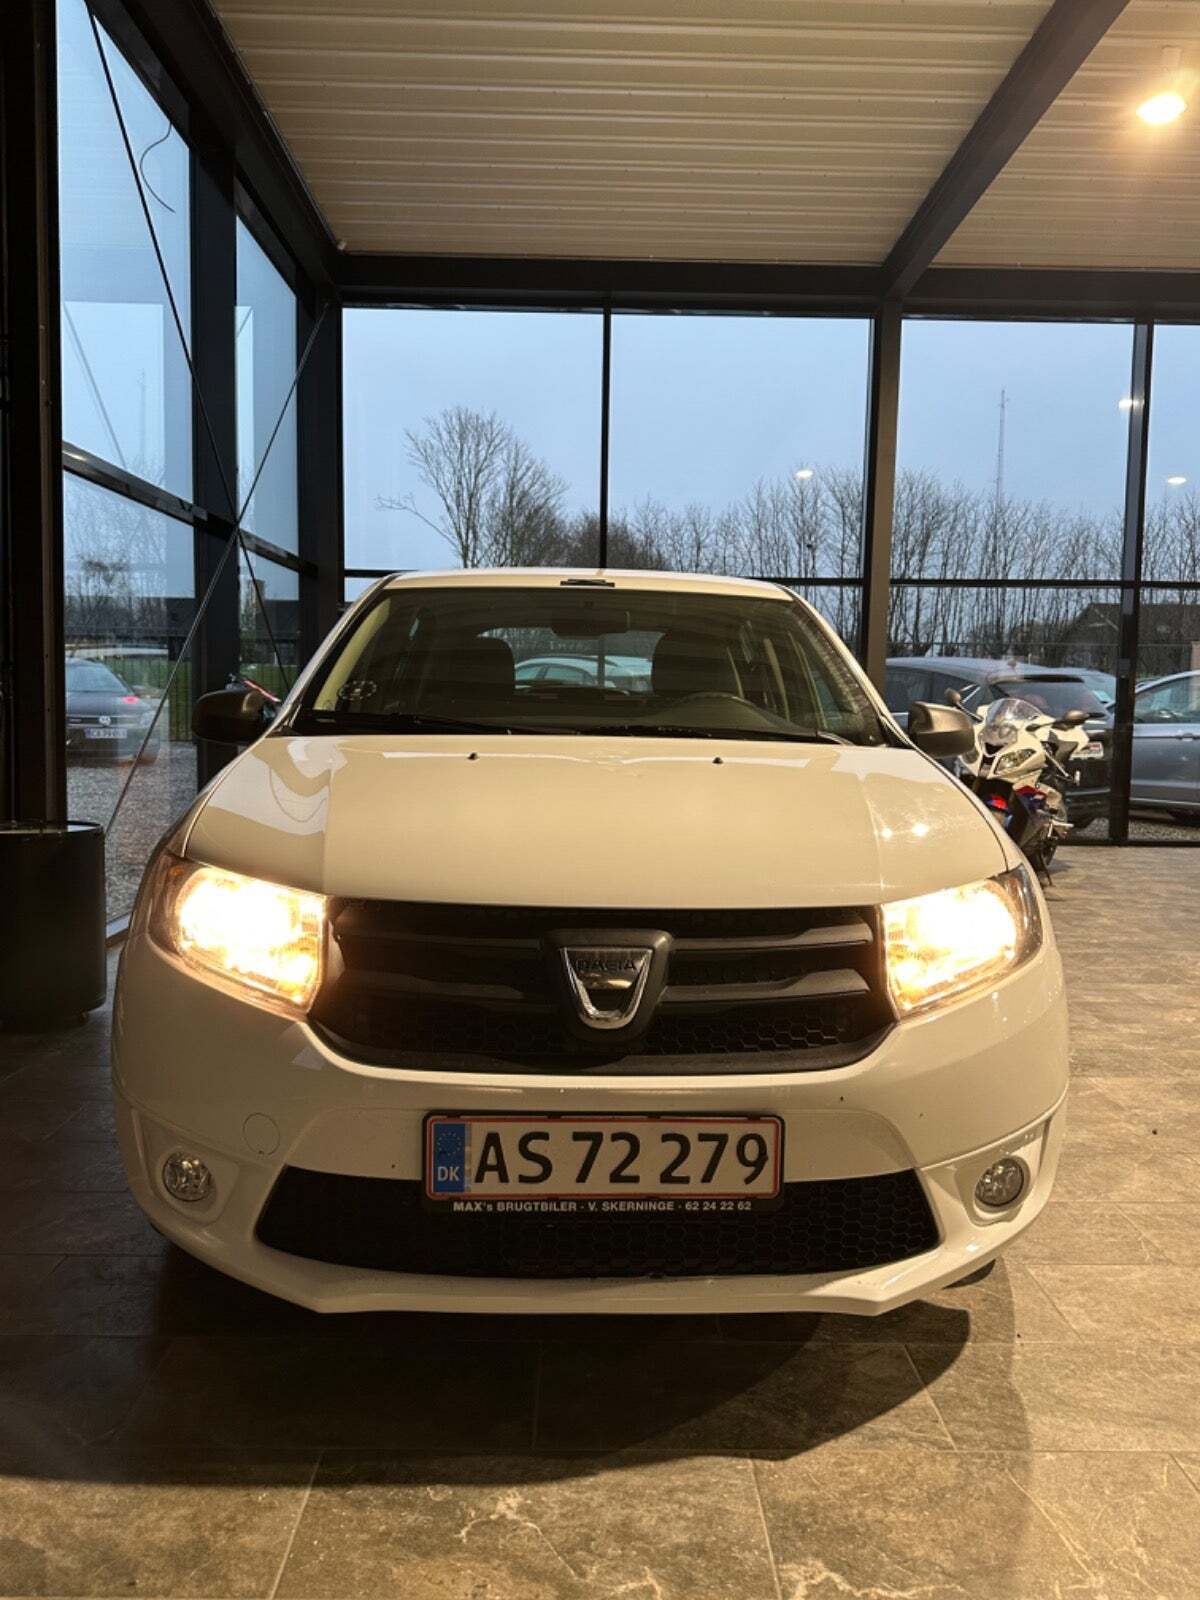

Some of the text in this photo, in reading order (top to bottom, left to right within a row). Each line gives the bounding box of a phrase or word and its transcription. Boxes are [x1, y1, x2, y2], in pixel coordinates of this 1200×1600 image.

[474, 1131, 768, 1185] AS 72 279
[437, 1166, 460, 1182] DK
[496, 1201, 577, 1212] BRUGTBILER
[602, 1201, 675, 1212] SKERNINGE
[685, 1201, 699, 1211] 62
[703, 1201, 717, 1211] 24
[720, 1201, 734, 1211] 22
